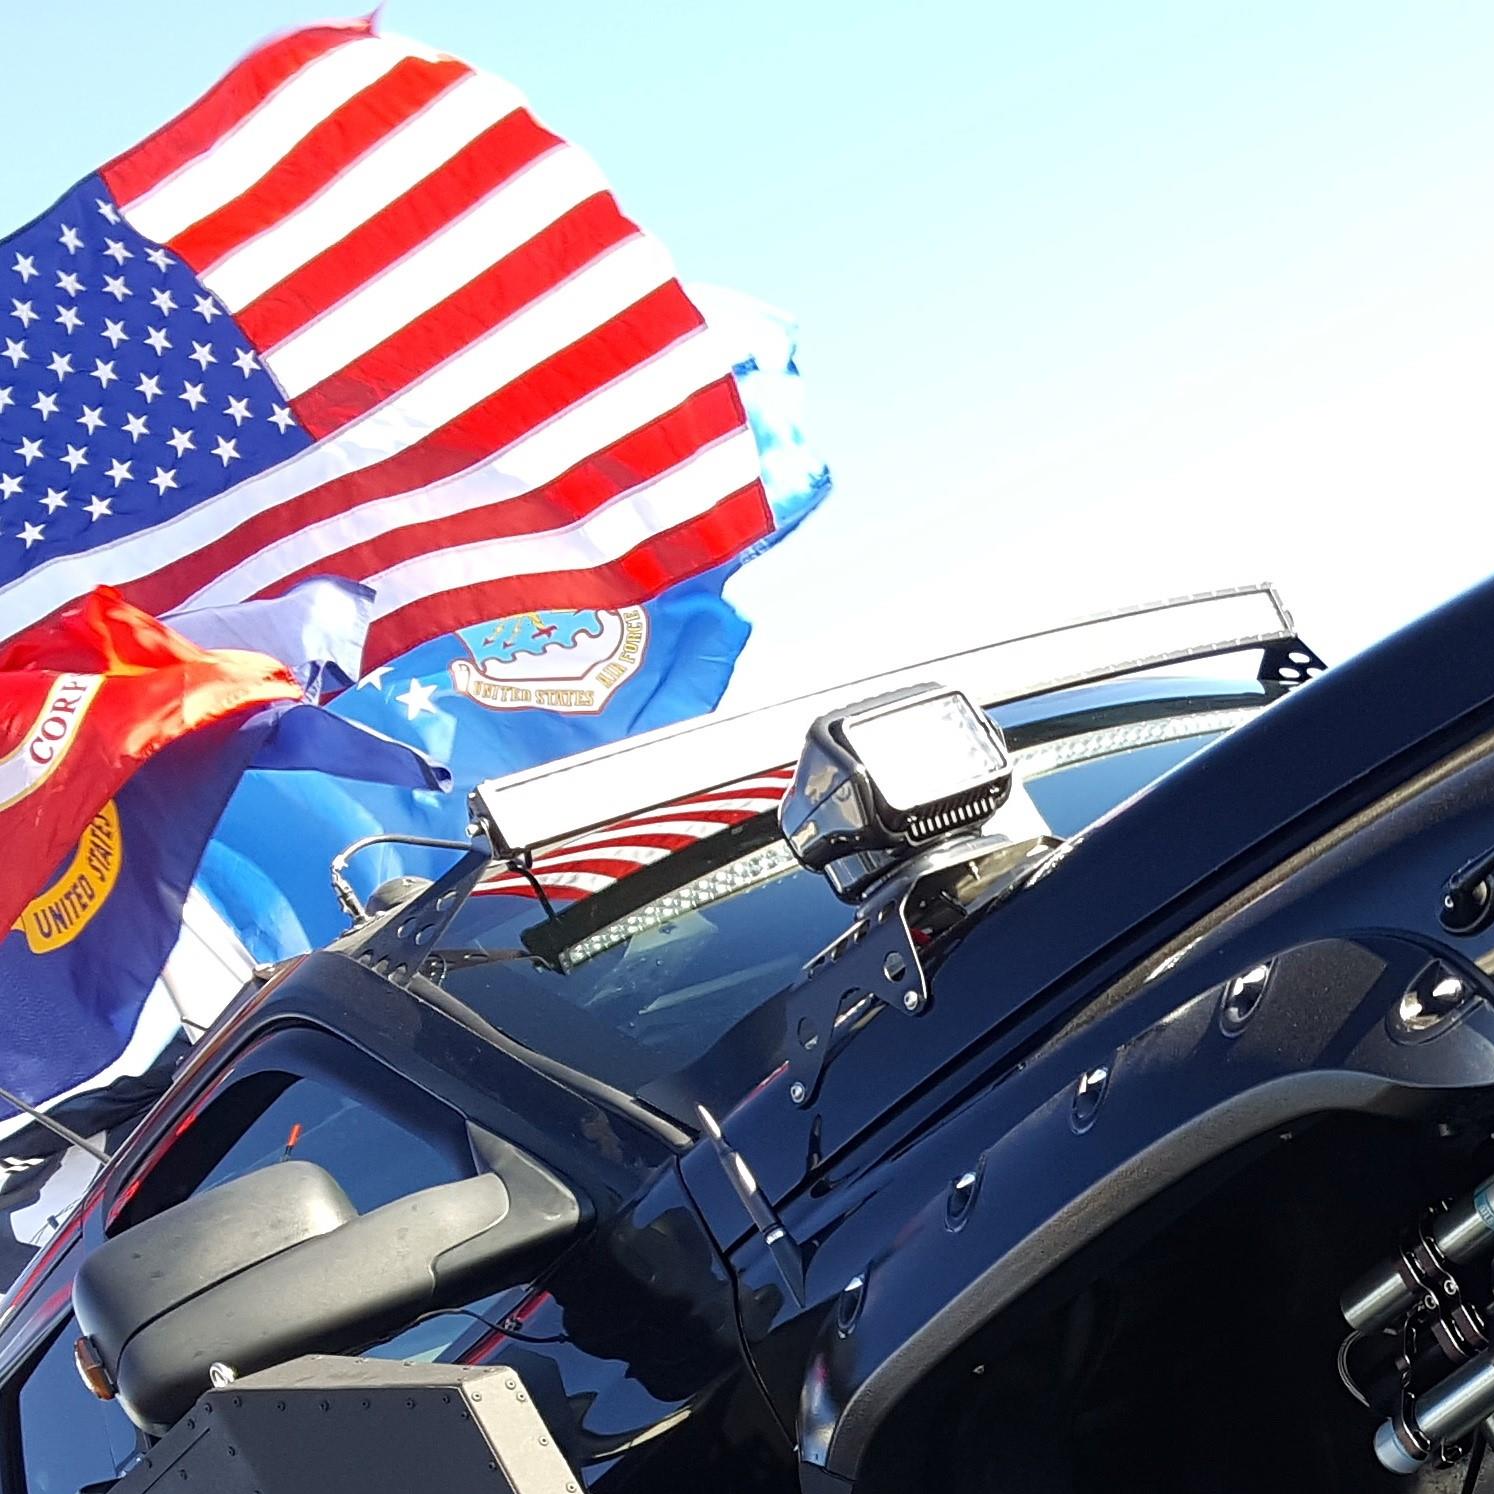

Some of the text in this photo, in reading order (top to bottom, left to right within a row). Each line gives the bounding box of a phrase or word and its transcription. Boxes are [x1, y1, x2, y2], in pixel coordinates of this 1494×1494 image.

[473, 610, 643, 706] UNITED STATES AIR FORCE
[33, 874, 96, 939] UNITED
